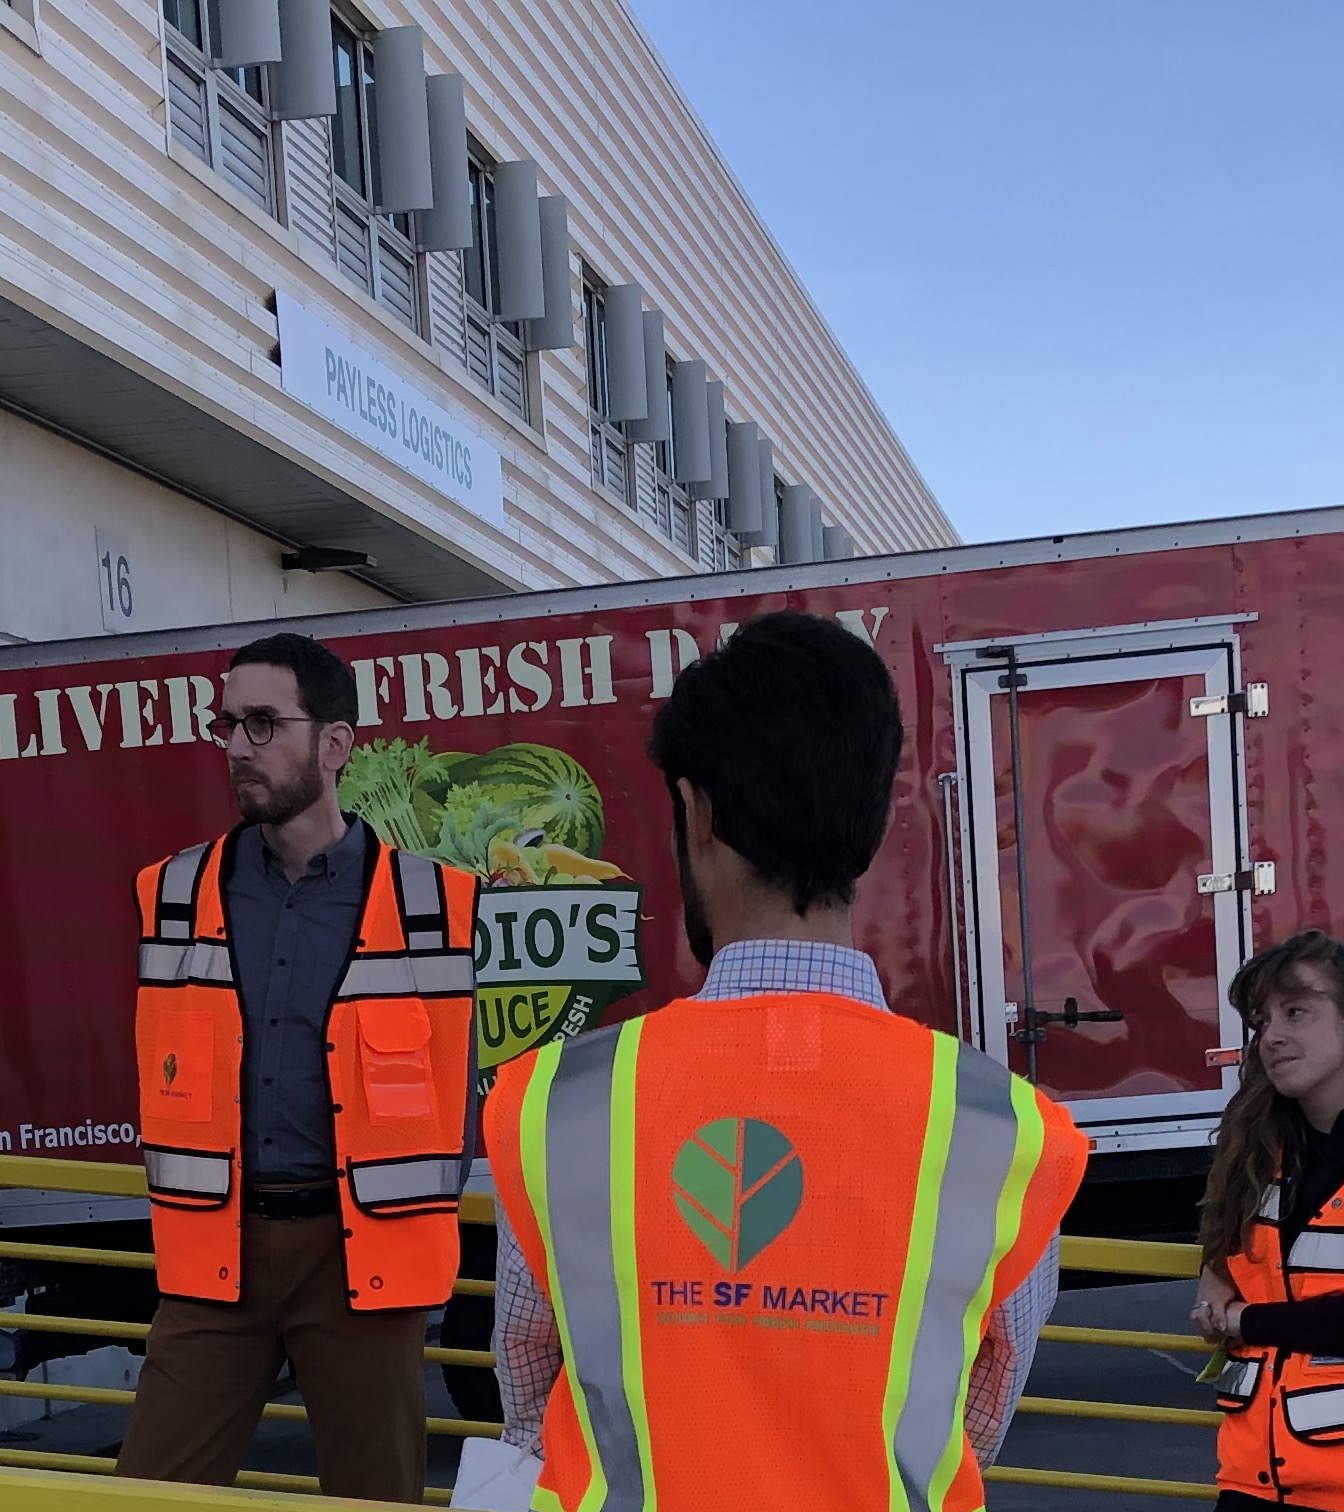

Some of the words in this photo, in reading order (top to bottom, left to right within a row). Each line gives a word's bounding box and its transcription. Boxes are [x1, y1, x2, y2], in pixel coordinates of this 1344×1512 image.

[324, 346, 398, 440] PAYLESS
[400, 400, 473, 490] LOGISTICS
[101, 550, 133, 618] 16
[350, 635, 618, 728] FRESH
[478, 990, 551, 1049] UCE
[19, 1118, 143, 1150] Francisco,
[650, 1281, 704, 1306] THE
[713, 1281, 753, 1307] SF
[762, 1285, 890, 1318] MARKET
